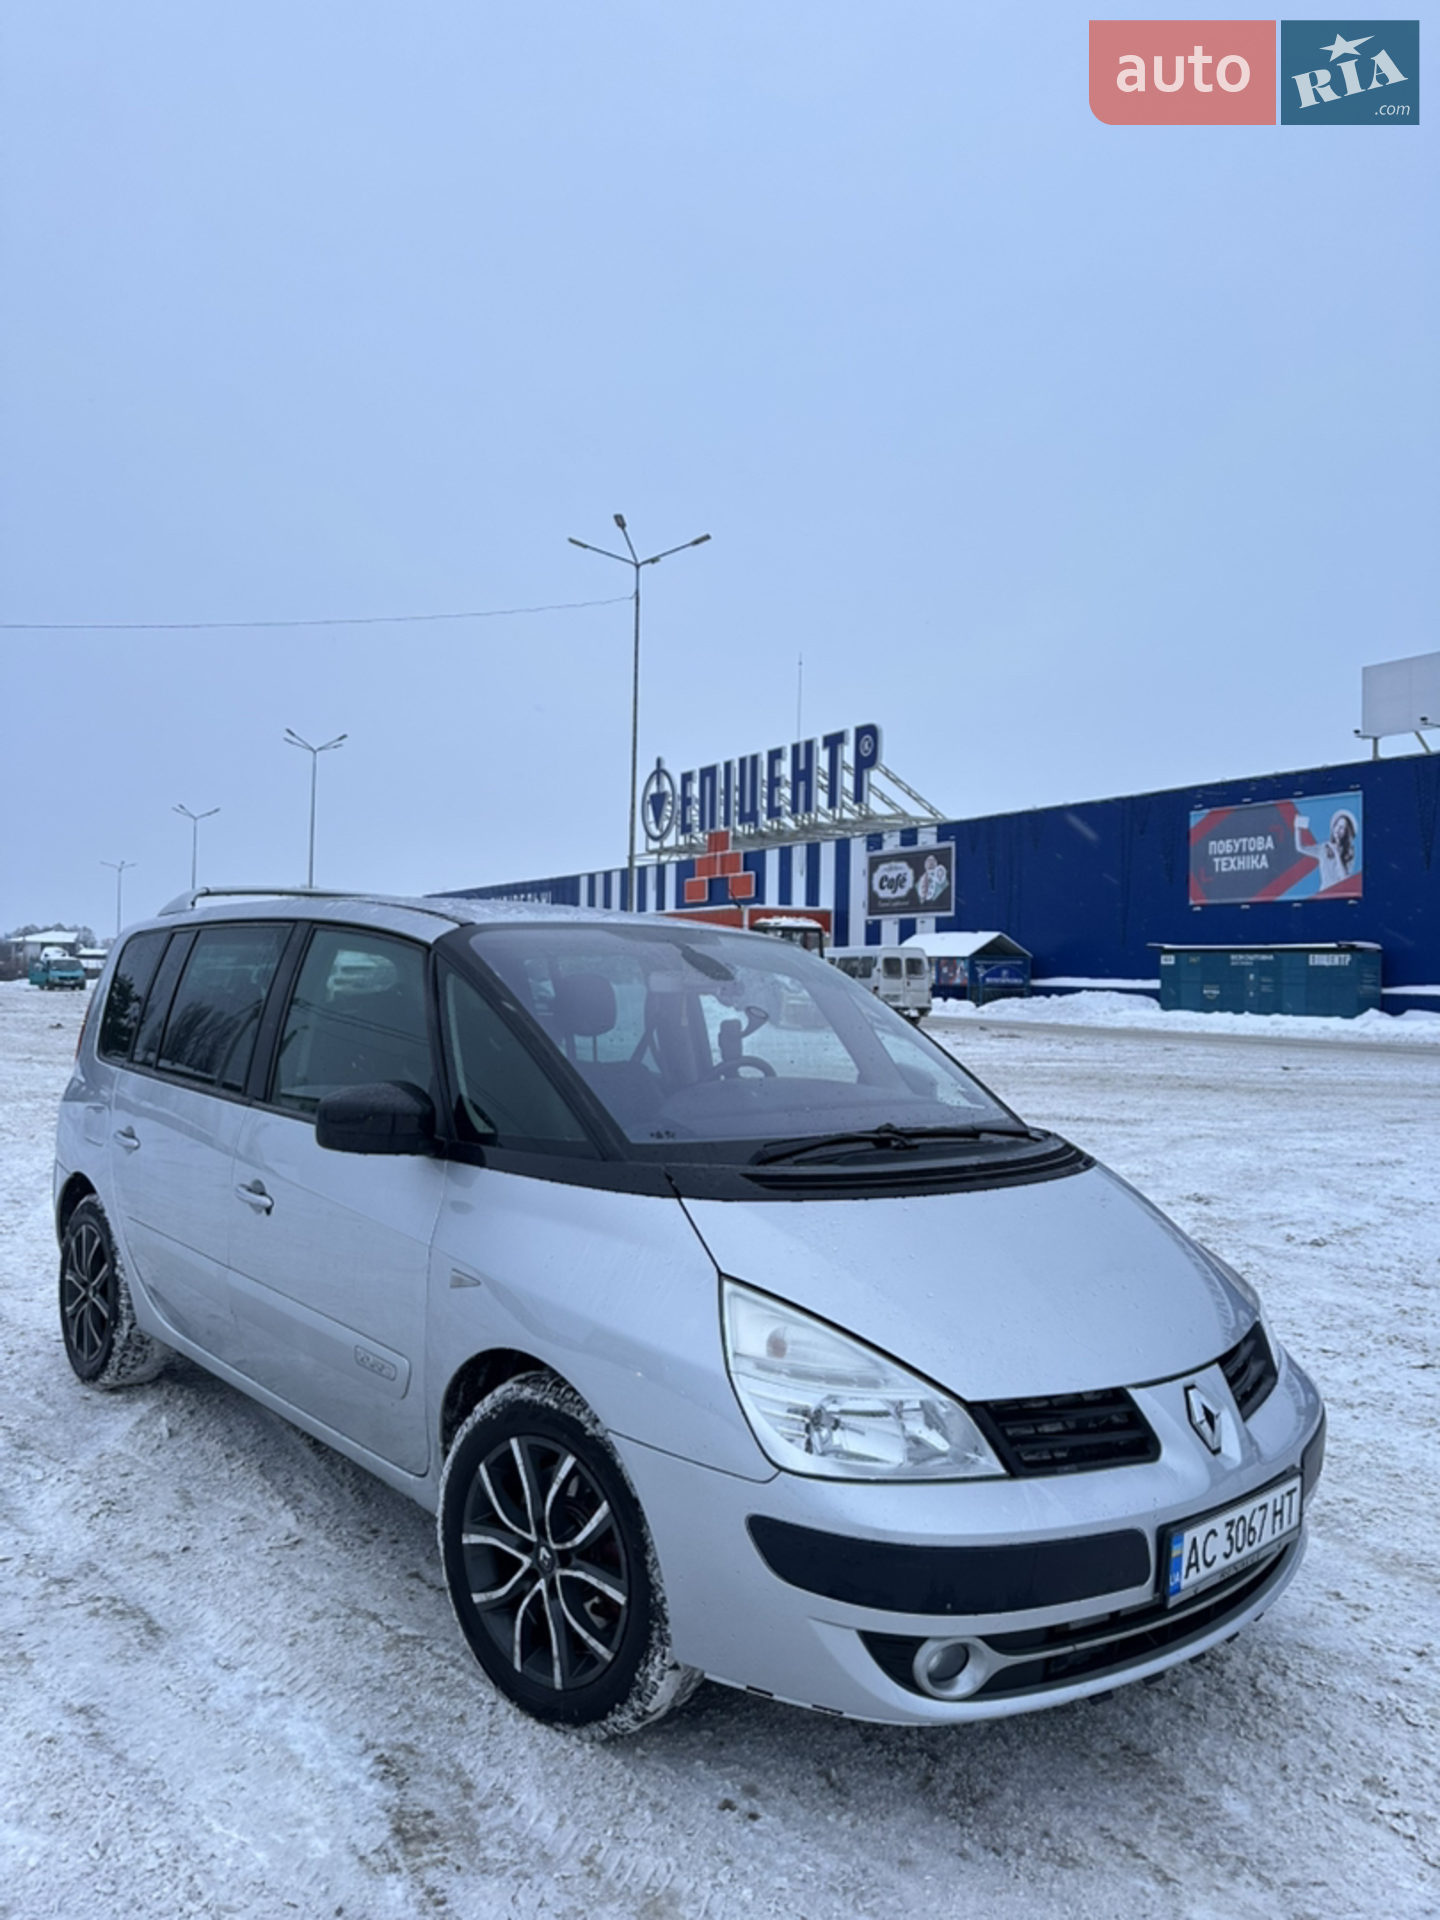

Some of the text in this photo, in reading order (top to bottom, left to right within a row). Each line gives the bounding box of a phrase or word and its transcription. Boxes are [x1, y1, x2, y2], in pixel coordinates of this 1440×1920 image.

[680, 722, 882, 836] ЕПІЦЕНТР
[1208, 834, 1275, 856] ПОБУТОВА
[1213, 853, 1270, 873] ТЕХНІКА
[878, 872, 908, 895] Café
[1308, 954, 1352, 967] ЕПІЦЕНТР
[1184, 1528, 1218, 1580] AC
[1223, 1502, 1269, 1560] 3067
[1271, 1486, 1298, 1536] HT
